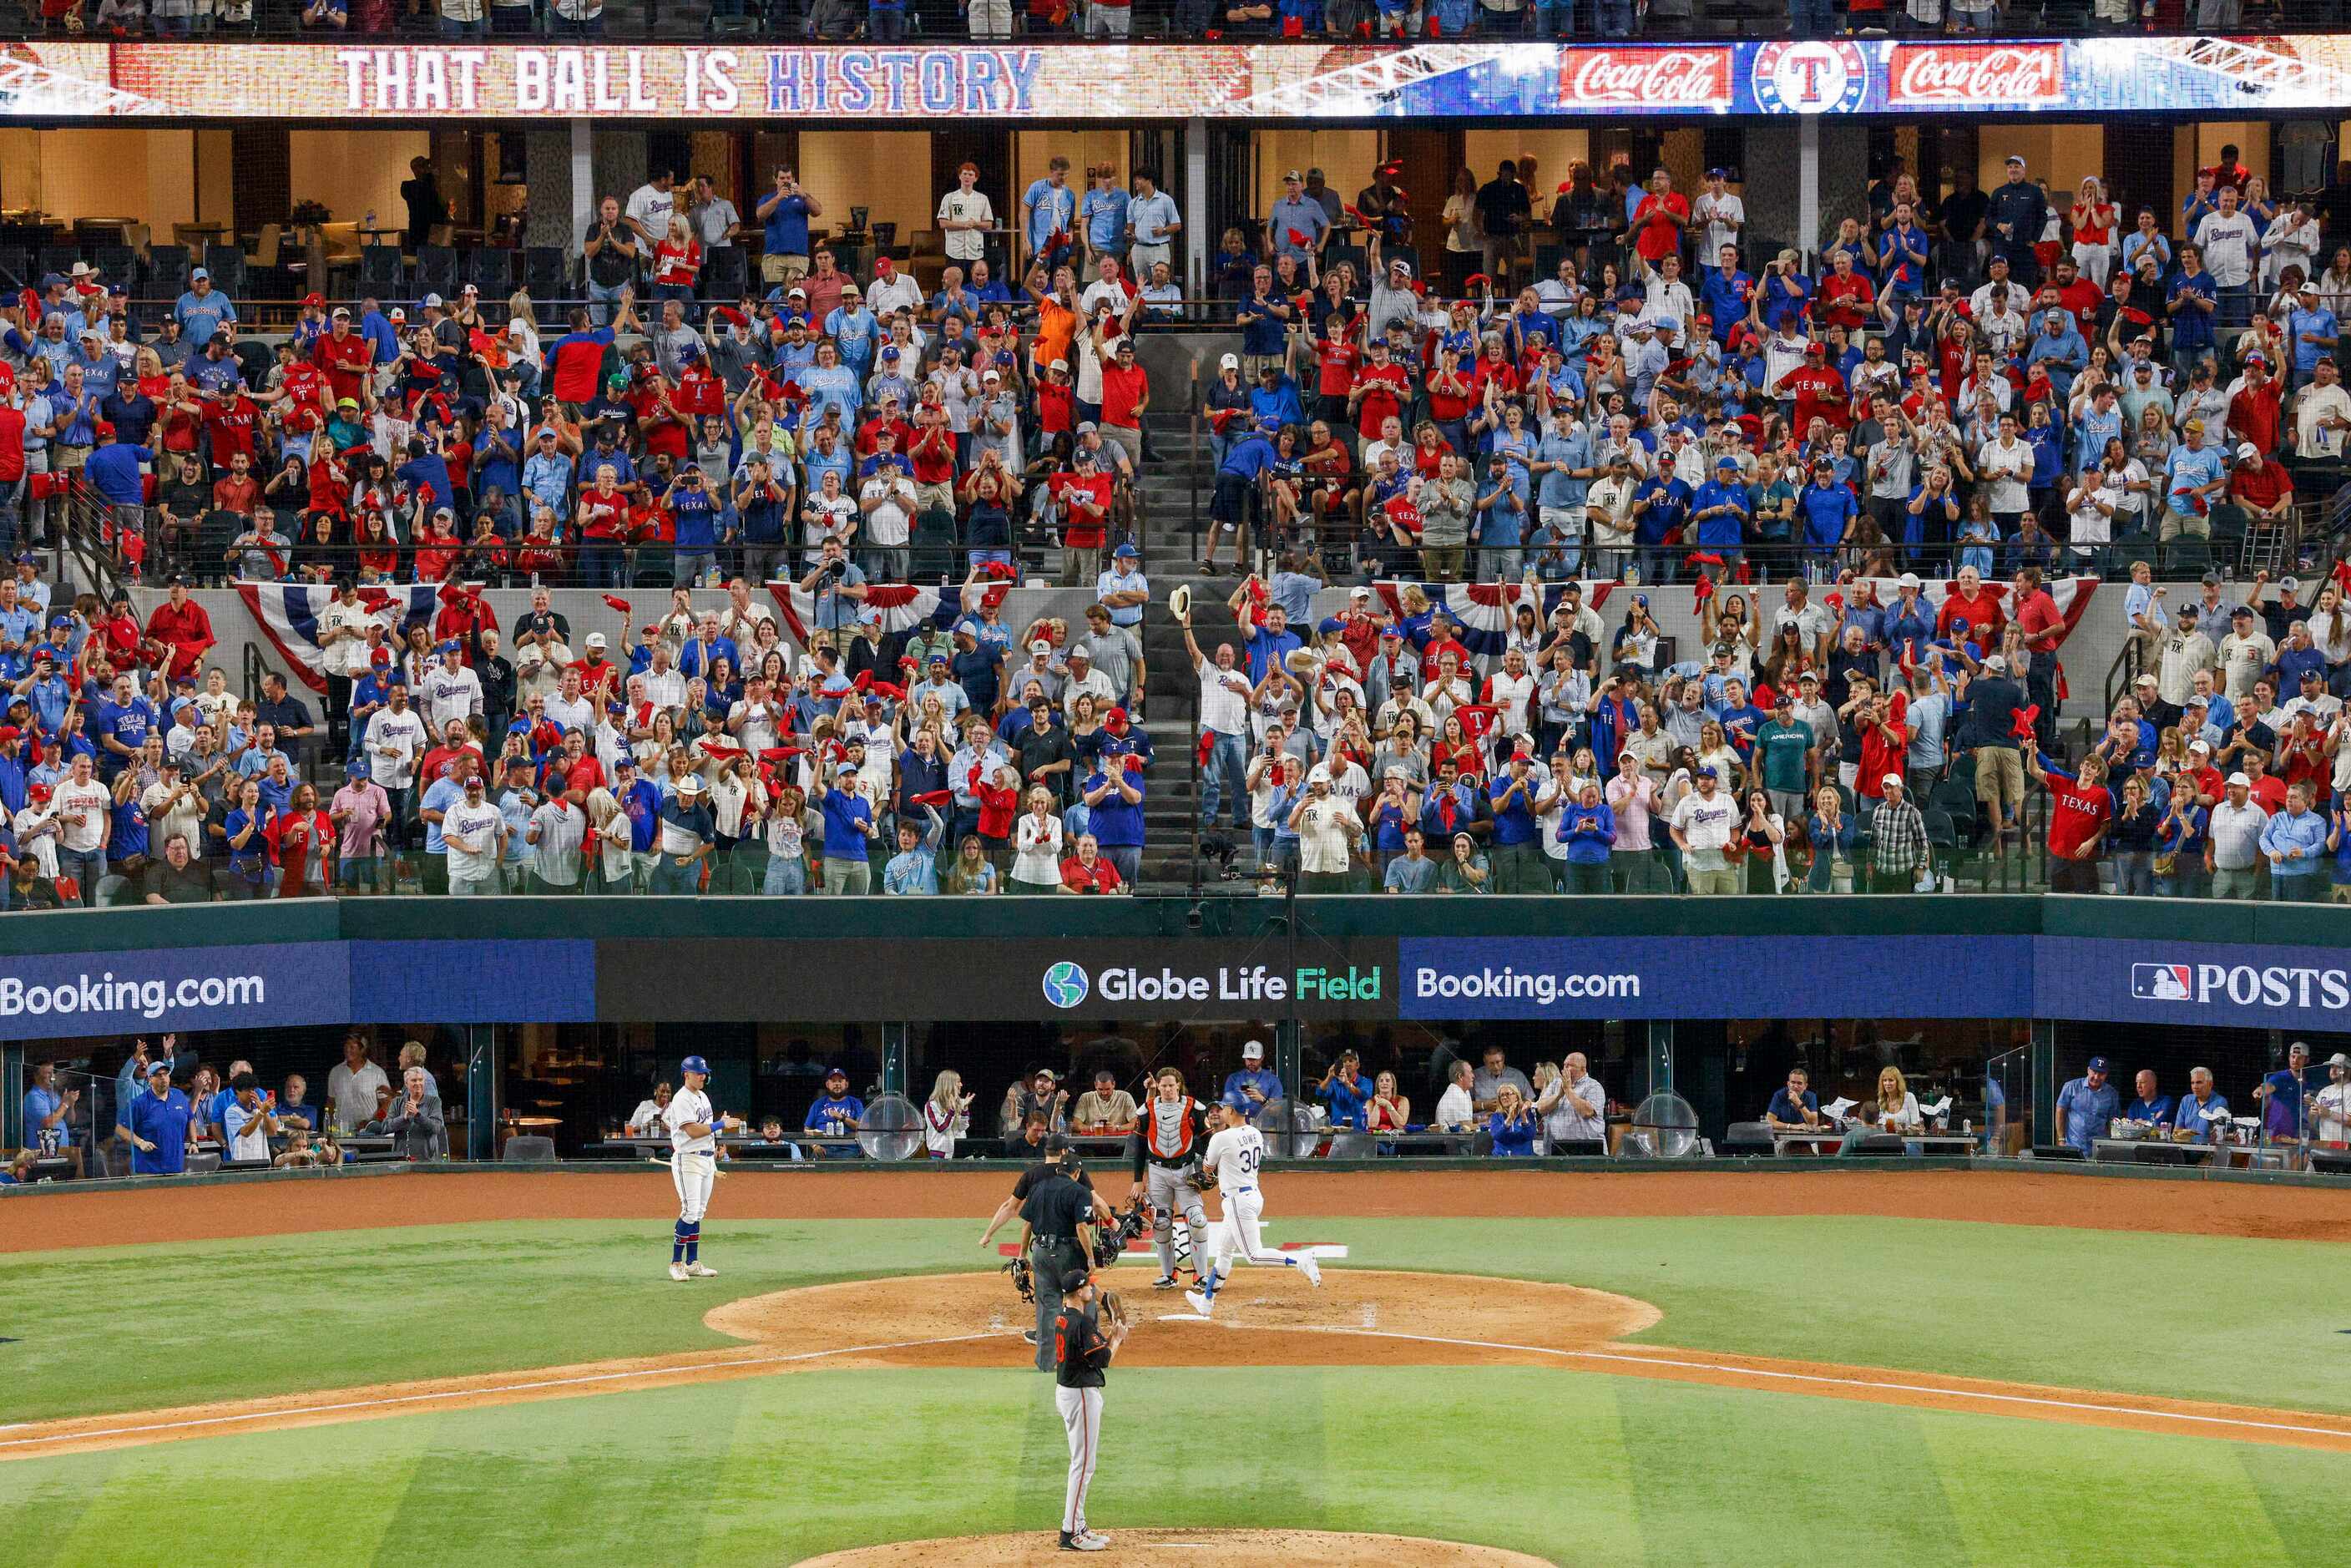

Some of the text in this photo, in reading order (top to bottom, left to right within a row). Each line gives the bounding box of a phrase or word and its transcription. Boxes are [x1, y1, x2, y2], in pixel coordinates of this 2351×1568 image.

[1574, 53, 1721, 100] Coca-Cola
[1790, 56, 1831, 103] T
[1901, 49, 2049, 98] Coca-Cola
[337, 50, 1043, 114] THAT BALL IS HISTORY
[2211, 229, 2243, 240] Rangers
[1622, 319, 1656, 335] Rangers
[436, 684, 470, 698] Rangers
[118, 716, 146, 725] TEXAS
[1469, 712, 1484, 729] T
[382, 722, 414, 737] Rangers
[1129, 740, 1136, 748] T
[861, 781, 867, 791] 5
[625, 796, 633, 804] T
[2062, 795, 2097, 816] TEXAS
[1695, 808, 1727, 822] Rangers
[461, 818, 493, 834] Rangers
[1098, 966, 1381, 1001] Globe Life Field
[1416, 967, 1640, 1004] Booking.com
[2197, 964, 2351, 1009] POSTS
[0, 972, 265, 1019] Booking.com
[2097, 1059, 2104, 1067] T
[1238, 1138, 1257, 1147] LOWE
[1239, 1146, 1261, 1174] 30
[1084, 1205, 1092, 1216] 7
